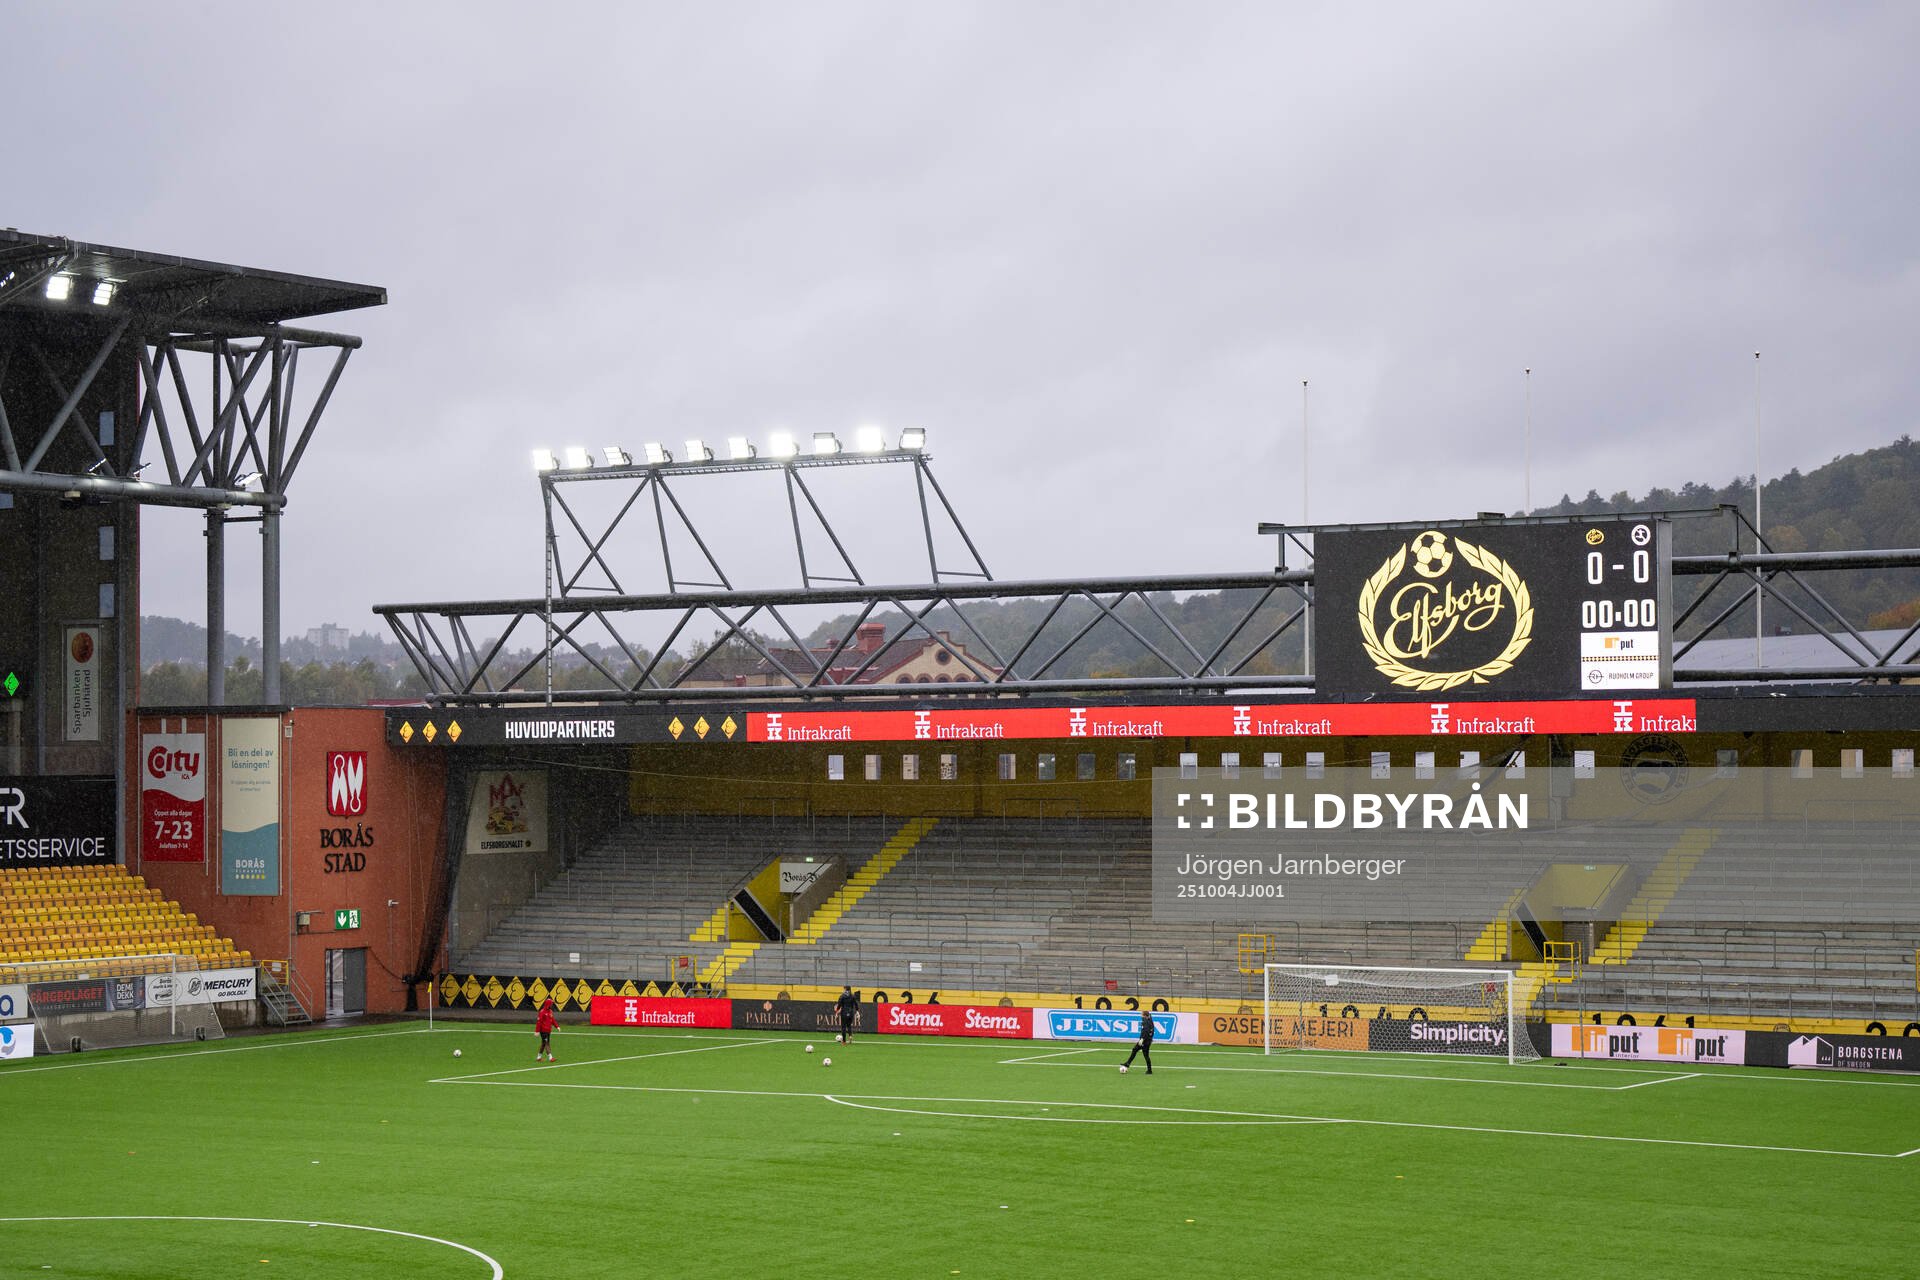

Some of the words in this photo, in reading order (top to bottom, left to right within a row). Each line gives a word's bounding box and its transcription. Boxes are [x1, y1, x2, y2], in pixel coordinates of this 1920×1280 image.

[1587, 552, 1603, 584] 0
[1633, 550, 1649, 583] 0
[1384, 581, 1504, 659] Elfsborg
[73, 670, 82, 734] Sparbanken
[505, 720, 615, 739] HUVUDPARTNERS
[788, 726, 852, 740] Infrakraft
[936, 723, 1004, 738] Infrakraft
[1093, 719, 1164, 736] Infrakraft
[1258, 719, 1332, 735] Infrakraft
[1457, 716, 1535, 733] Infrakraft
[228, 748, 237, 757] Bli
[250, 748, 263, 757] del
[147, 745, 200, 779] City
[231, 760, 270, 771] lösningen!
[154, 820, 193, 840] 7-23
[320, 822, 374, 849] BORÅS
[235, 857, 265, 868] BORÅS
[324, 852, 367, 874] STAD
[204, 978, 253, 991] MERCURY
[641, 1011, 695, 1024] Infrakraft
[746, 1011, 790, 1025] PARLER
[889, 1006, 944, 1027] Stema.
[965, 1008, 1021, 1030] Stema.
[1292, 1019, 1354, 1037] MEJERI
[1410, 1022, 1507, 1046] Simplicity.
[1838, 1046, 1903, 1060] BORGSTENA
